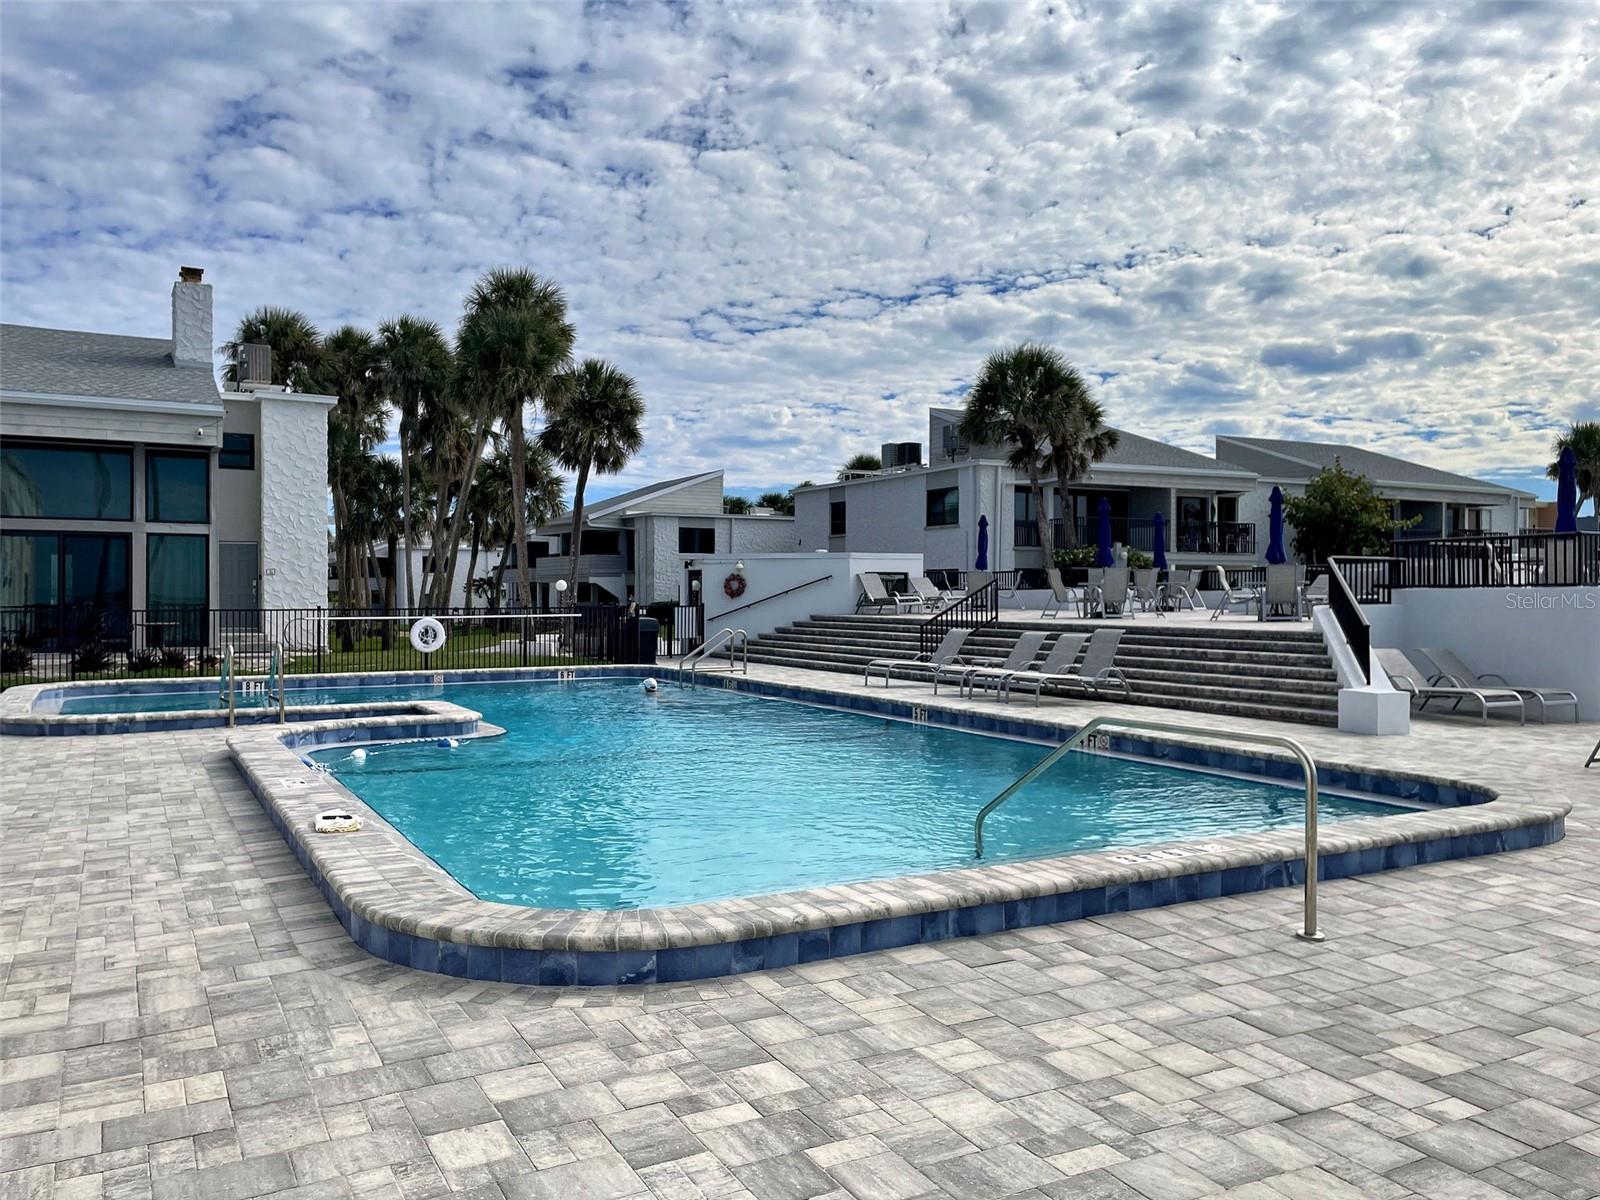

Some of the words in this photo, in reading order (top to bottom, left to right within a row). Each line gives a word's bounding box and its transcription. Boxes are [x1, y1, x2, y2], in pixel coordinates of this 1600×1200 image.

[566, 670, 575, 679] FT
[246, 681, 251, 690] 8
[254, 681, 264, 691] FT
[920, 708, 927, 721] FT
[1087, 733, 1097, 749] FT
